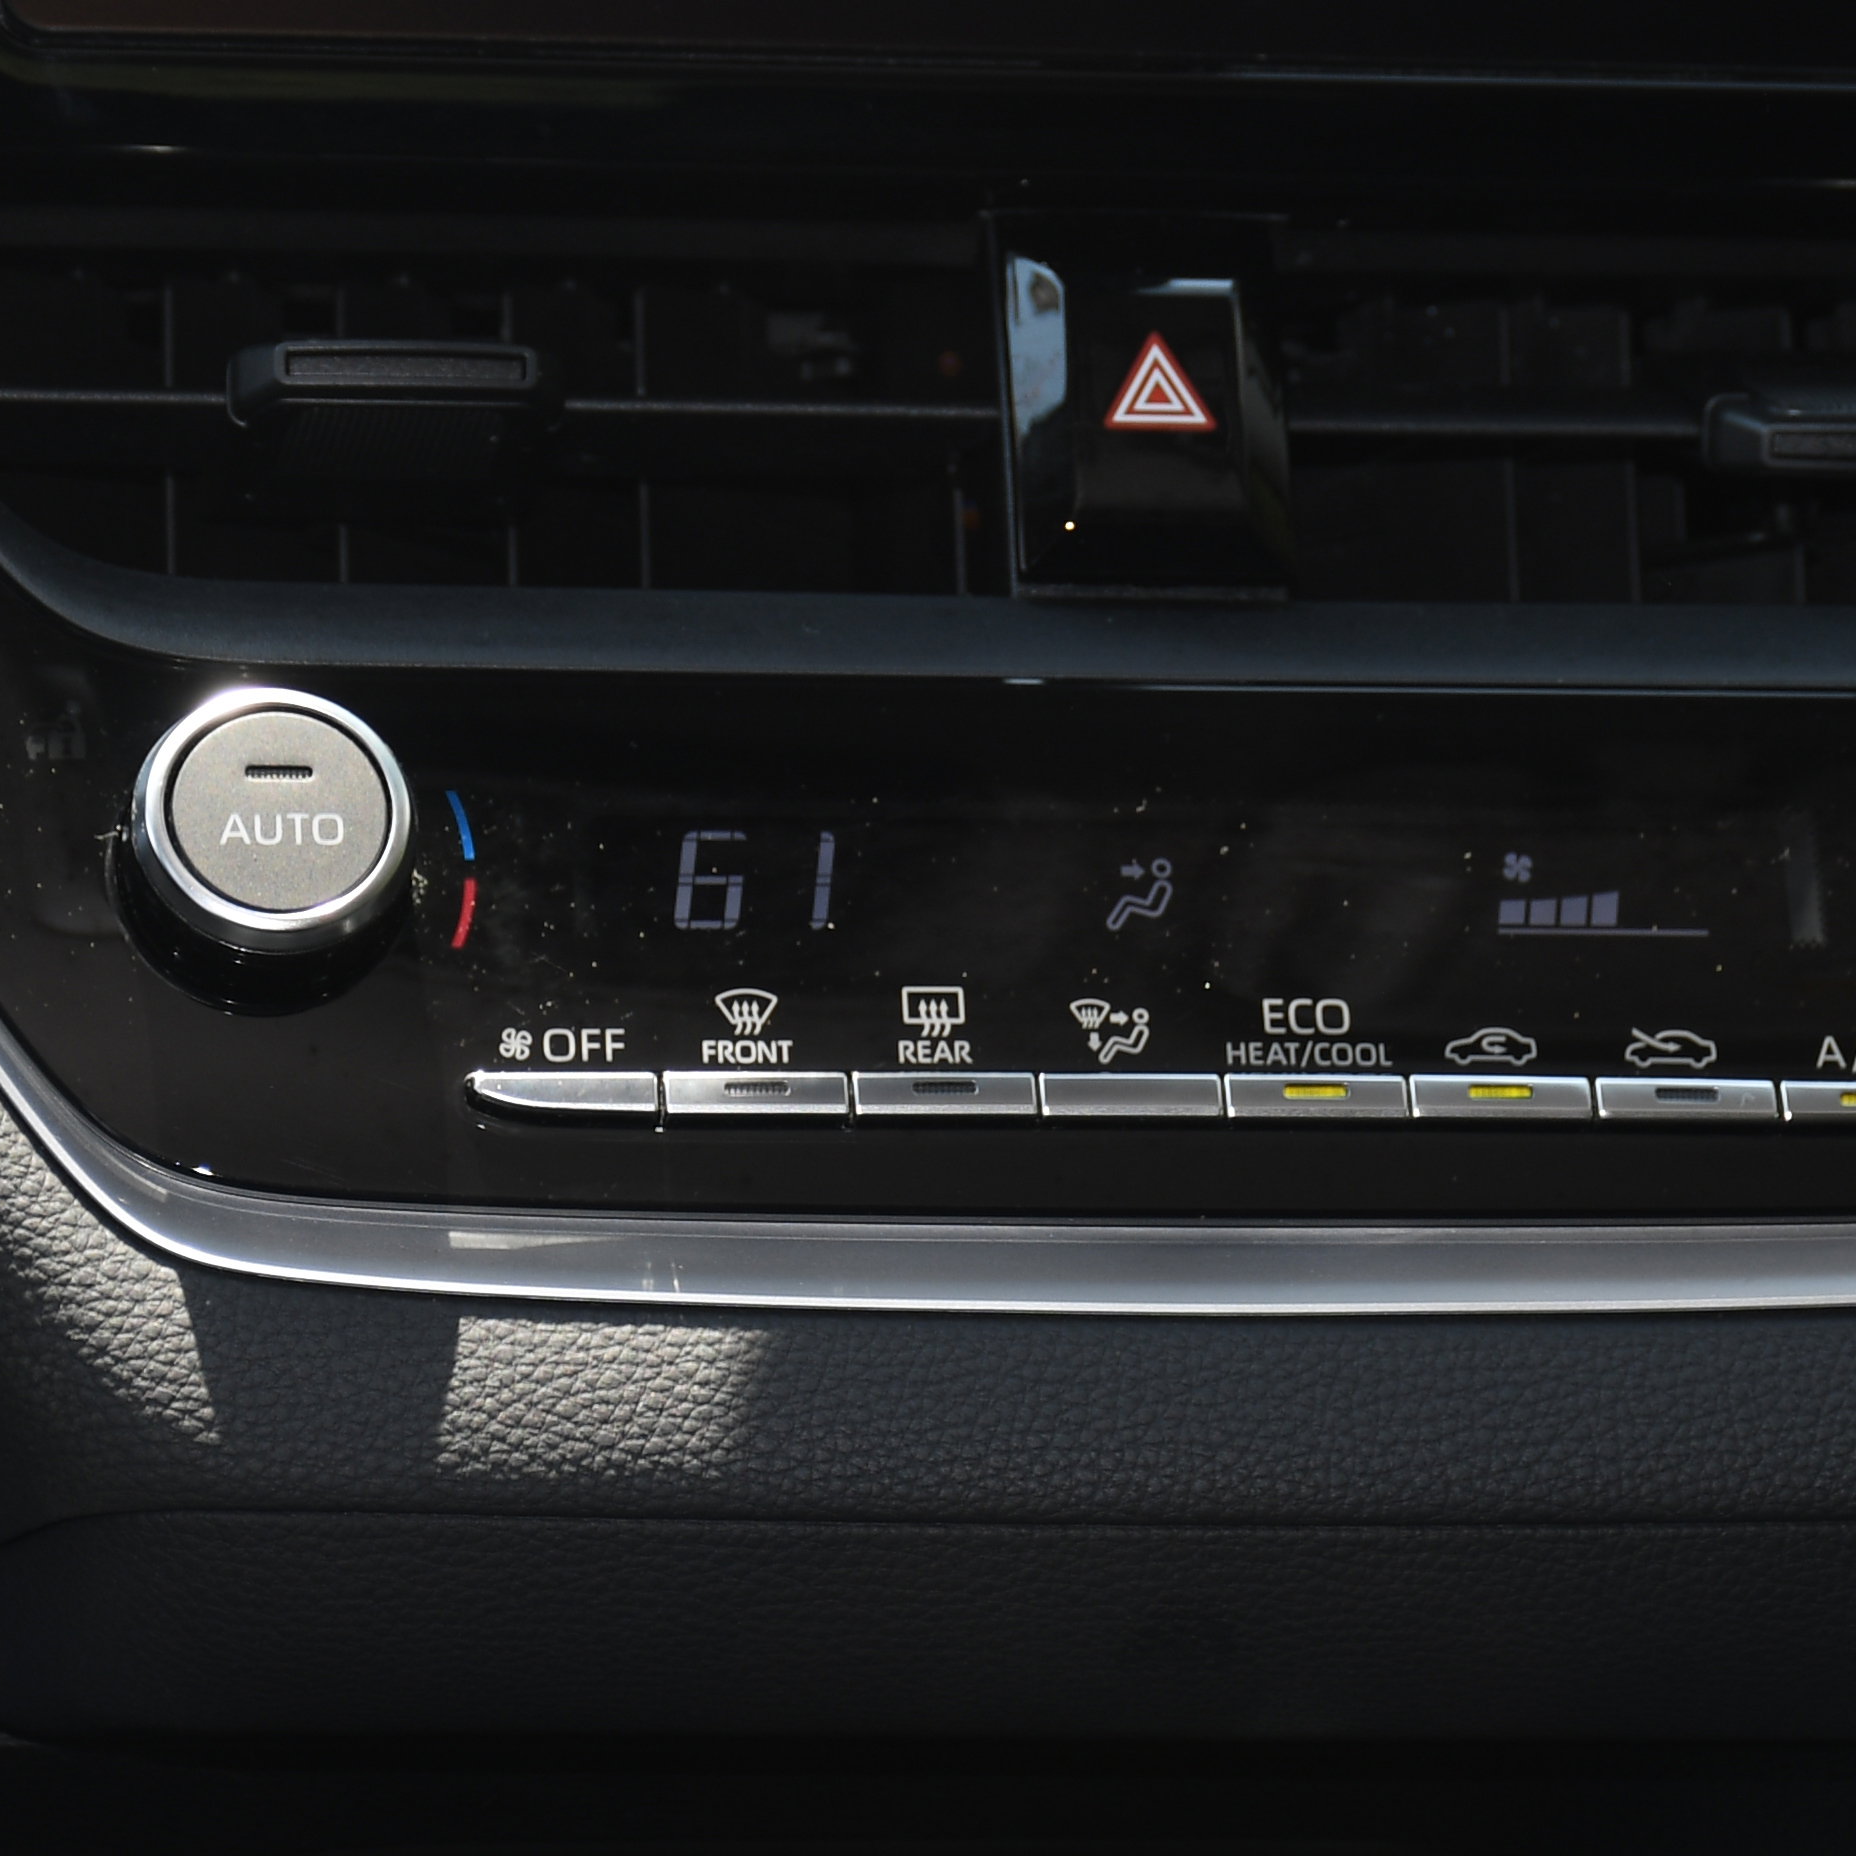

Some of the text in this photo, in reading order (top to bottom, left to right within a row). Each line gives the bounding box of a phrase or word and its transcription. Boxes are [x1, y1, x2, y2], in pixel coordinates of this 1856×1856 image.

[220, 813, 344, 845] AUTO
[674, 831, 835, 929] 61
[1263, 999, 1350, 1034] ECO
[543, 1029, 624, 1062] OFF
[702, 1040, 792, 1064] FRONT
[898, 1040, 972, 1063] REAR
[1226, 1041, 1392, 1067] HEAT/COOL
